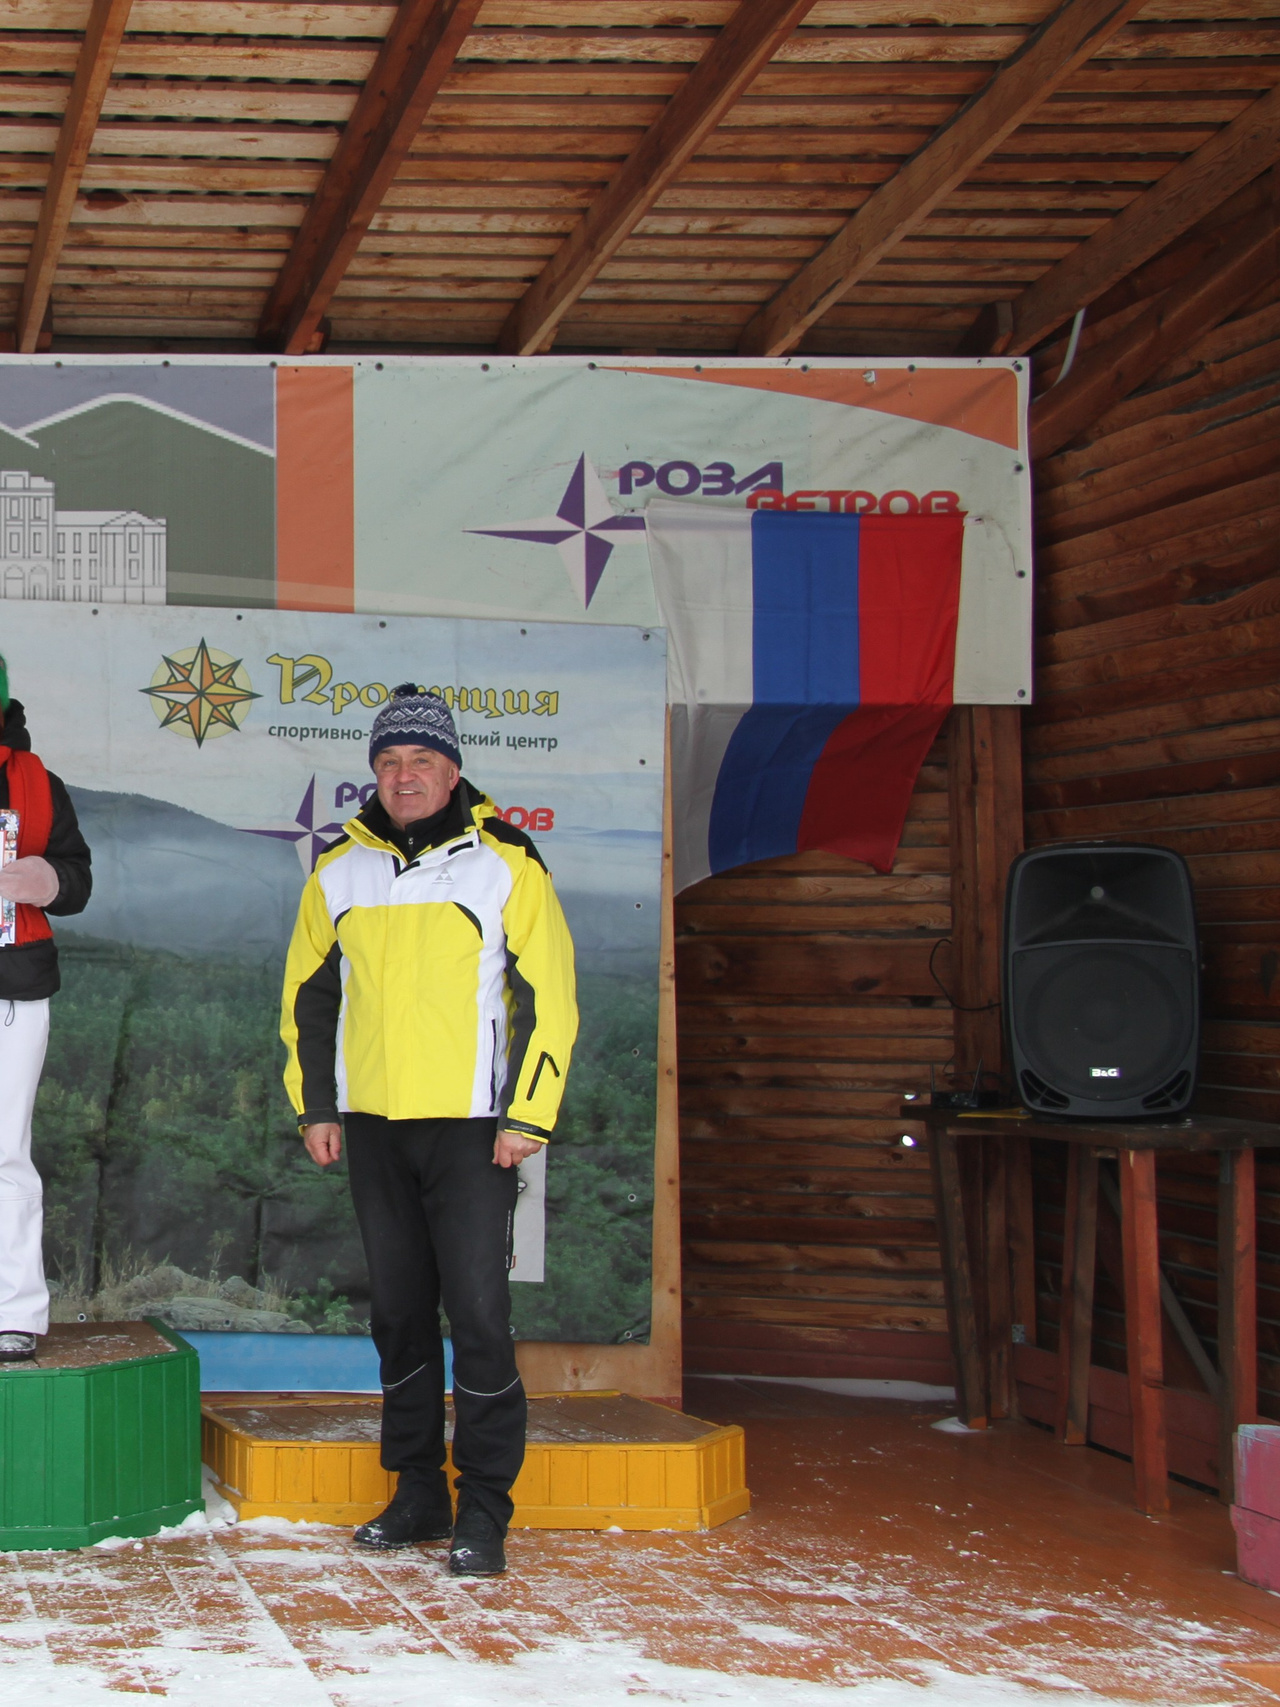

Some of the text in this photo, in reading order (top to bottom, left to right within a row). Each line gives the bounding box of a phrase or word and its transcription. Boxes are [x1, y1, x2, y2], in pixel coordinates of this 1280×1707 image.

[619, 461, 783, 496] РОЗА
[266, 653, 559, 719] Пронция
[268, 725, 558, 752] спортивно-ский центр
[1091, 1068, 1118, 1077] B&G
